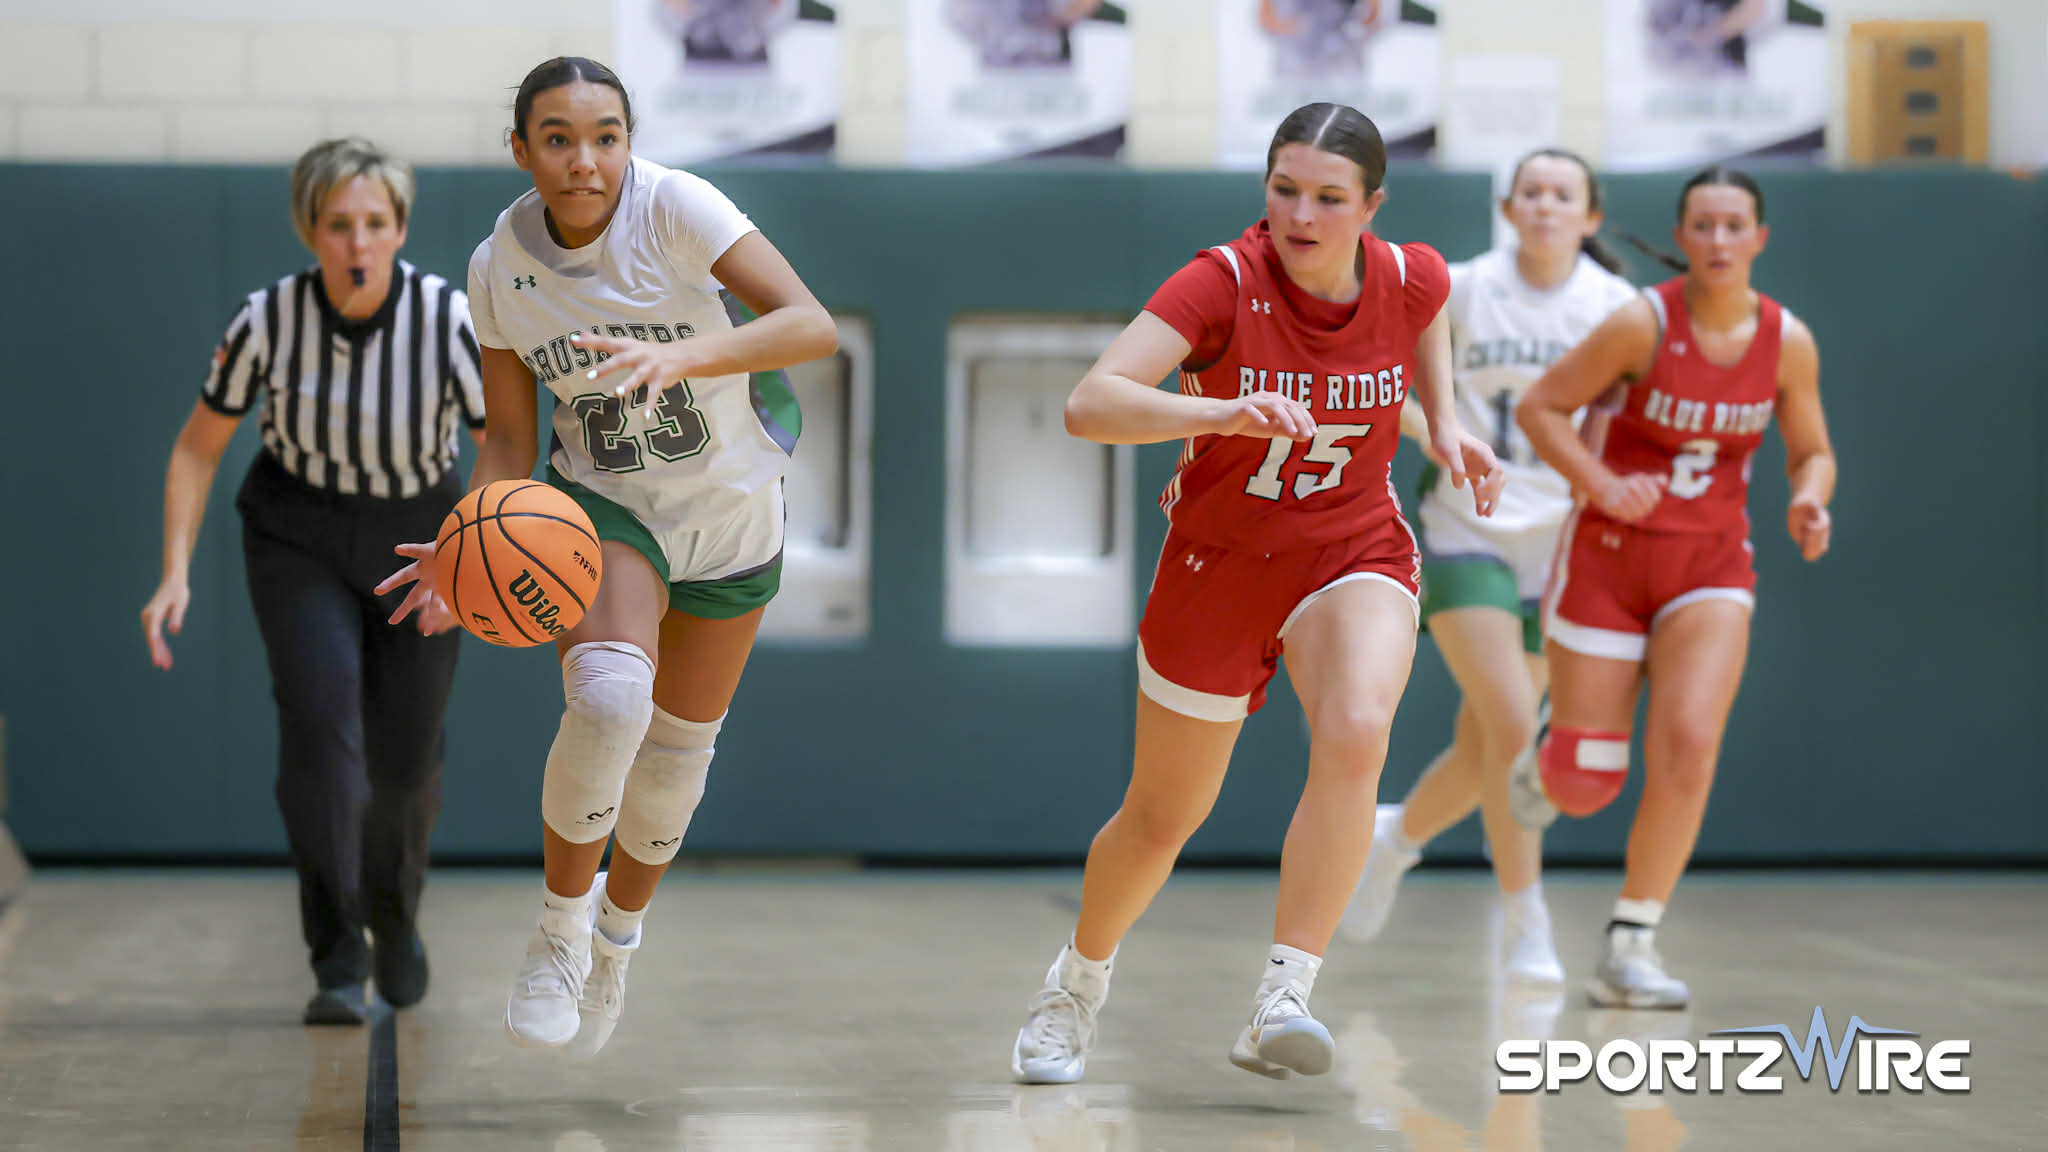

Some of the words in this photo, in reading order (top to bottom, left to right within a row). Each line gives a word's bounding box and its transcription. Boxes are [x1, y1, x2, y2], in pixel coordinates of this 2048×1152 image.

[1239, 366, 1314, 410] BLUE
[1325, 364, 1404, 411] RIDGE
[570, 379, 711, 474] 23
[1244, 423, 1373, 502] 15
[1668, 438, 1720, 499] 2
[508, 568, 569, 637] Wilso
